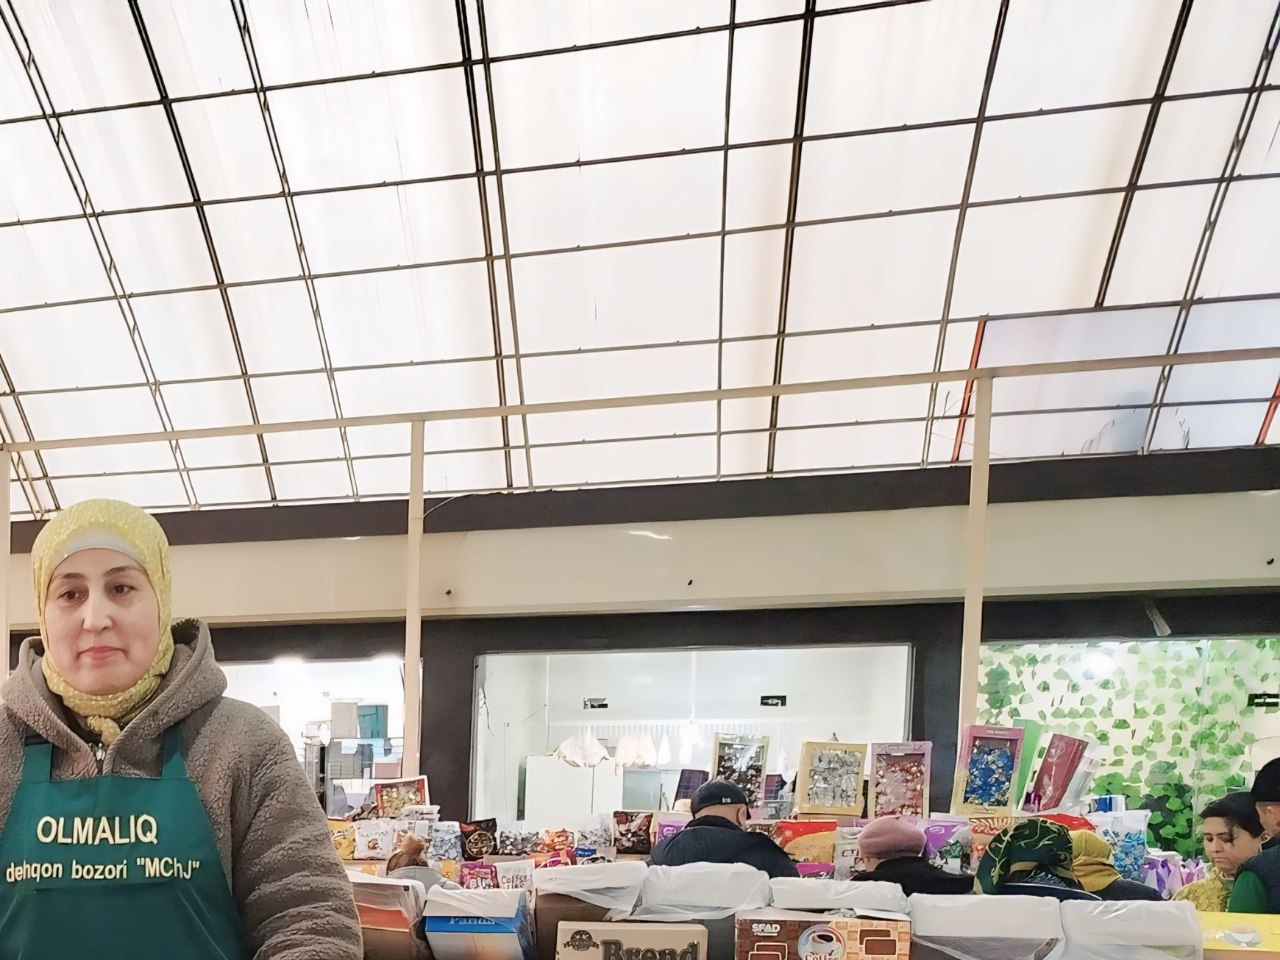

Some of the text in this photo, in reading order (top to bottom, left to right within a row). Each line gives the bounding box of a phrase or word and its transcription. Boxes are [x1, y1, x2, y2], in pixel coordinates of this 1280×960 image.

[36, 814, 159, 845] OLMALIQ
[6, 860, 63, 883] dehqon
[71, 859, 127, 880] bozori
